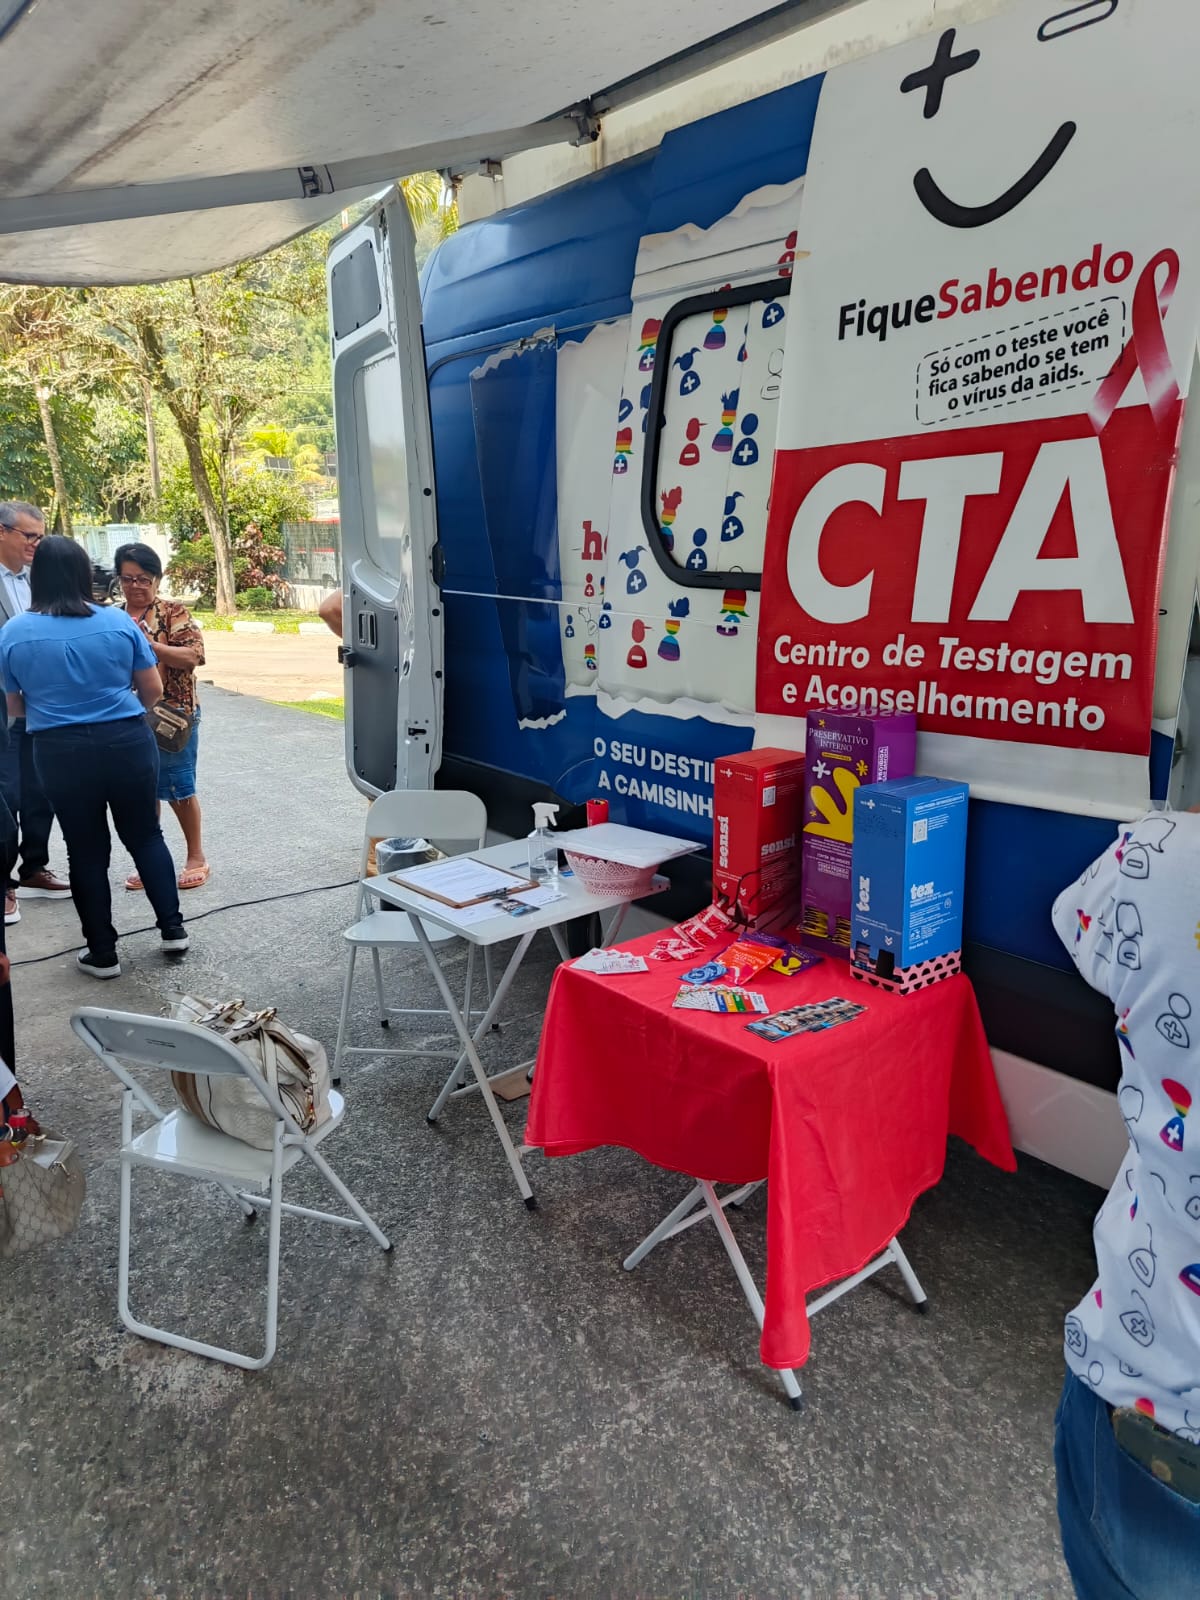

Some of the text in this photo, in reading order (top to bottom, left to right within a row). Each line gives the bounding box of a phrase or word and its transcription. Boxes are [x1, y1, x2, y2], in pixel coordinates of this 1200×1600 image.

[838, 243, 1134, 342] FiqueSabendo
[928, 333, 1110, 397] fica sabendo se tem
[930, 308, 1110, 378] Só com o teste você
[947, 362, 1085, 411] o vírus da aids.
[786, 435, 1135, 625] CTA
[774, 633, 1133, 685] Centro de Testagem
[782, 674, 1106, 732] e Aconselhamento
[594, 737, 606, 757] O
[610, 740, 646, 767] SEU
[809, 727, 869, 747] PRESERVATIVO
[598, 769, 611, 790] A
[717, 815, 729, 869] sensi
[761, 833, 796, 857] sensi
[856, 876, 870, 913] tex
[910, 881, 935, 899] tex
